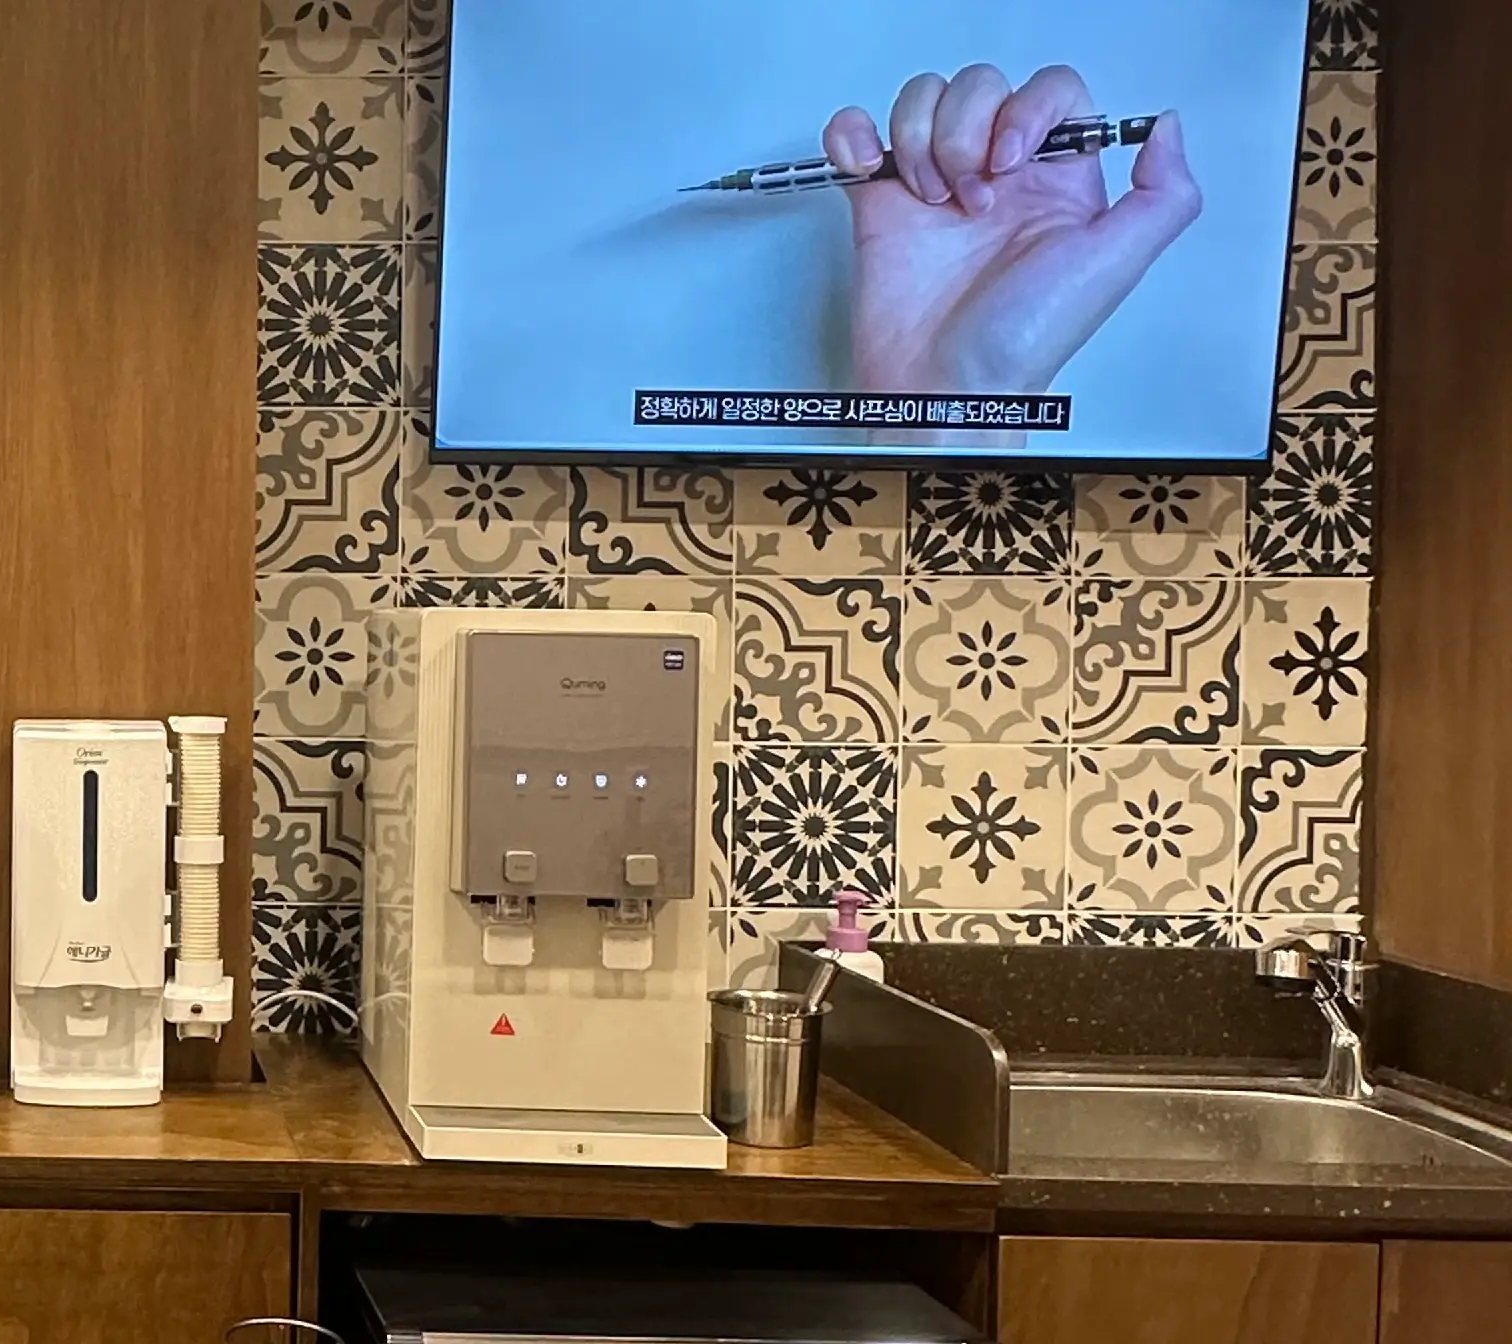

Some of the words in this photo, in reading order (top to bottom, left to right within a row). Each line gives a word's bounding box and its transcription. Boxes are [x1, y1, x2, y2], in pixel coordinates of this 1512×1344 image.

[641, 397, 718, 420] 정확하게
[722, 398, 781, 421] 일정한
[784, 399, 842, 422] 양으로
[845, 399, 923, 423] 샤프심이
[926, 400, 1066, 425] 배출되었습니다
